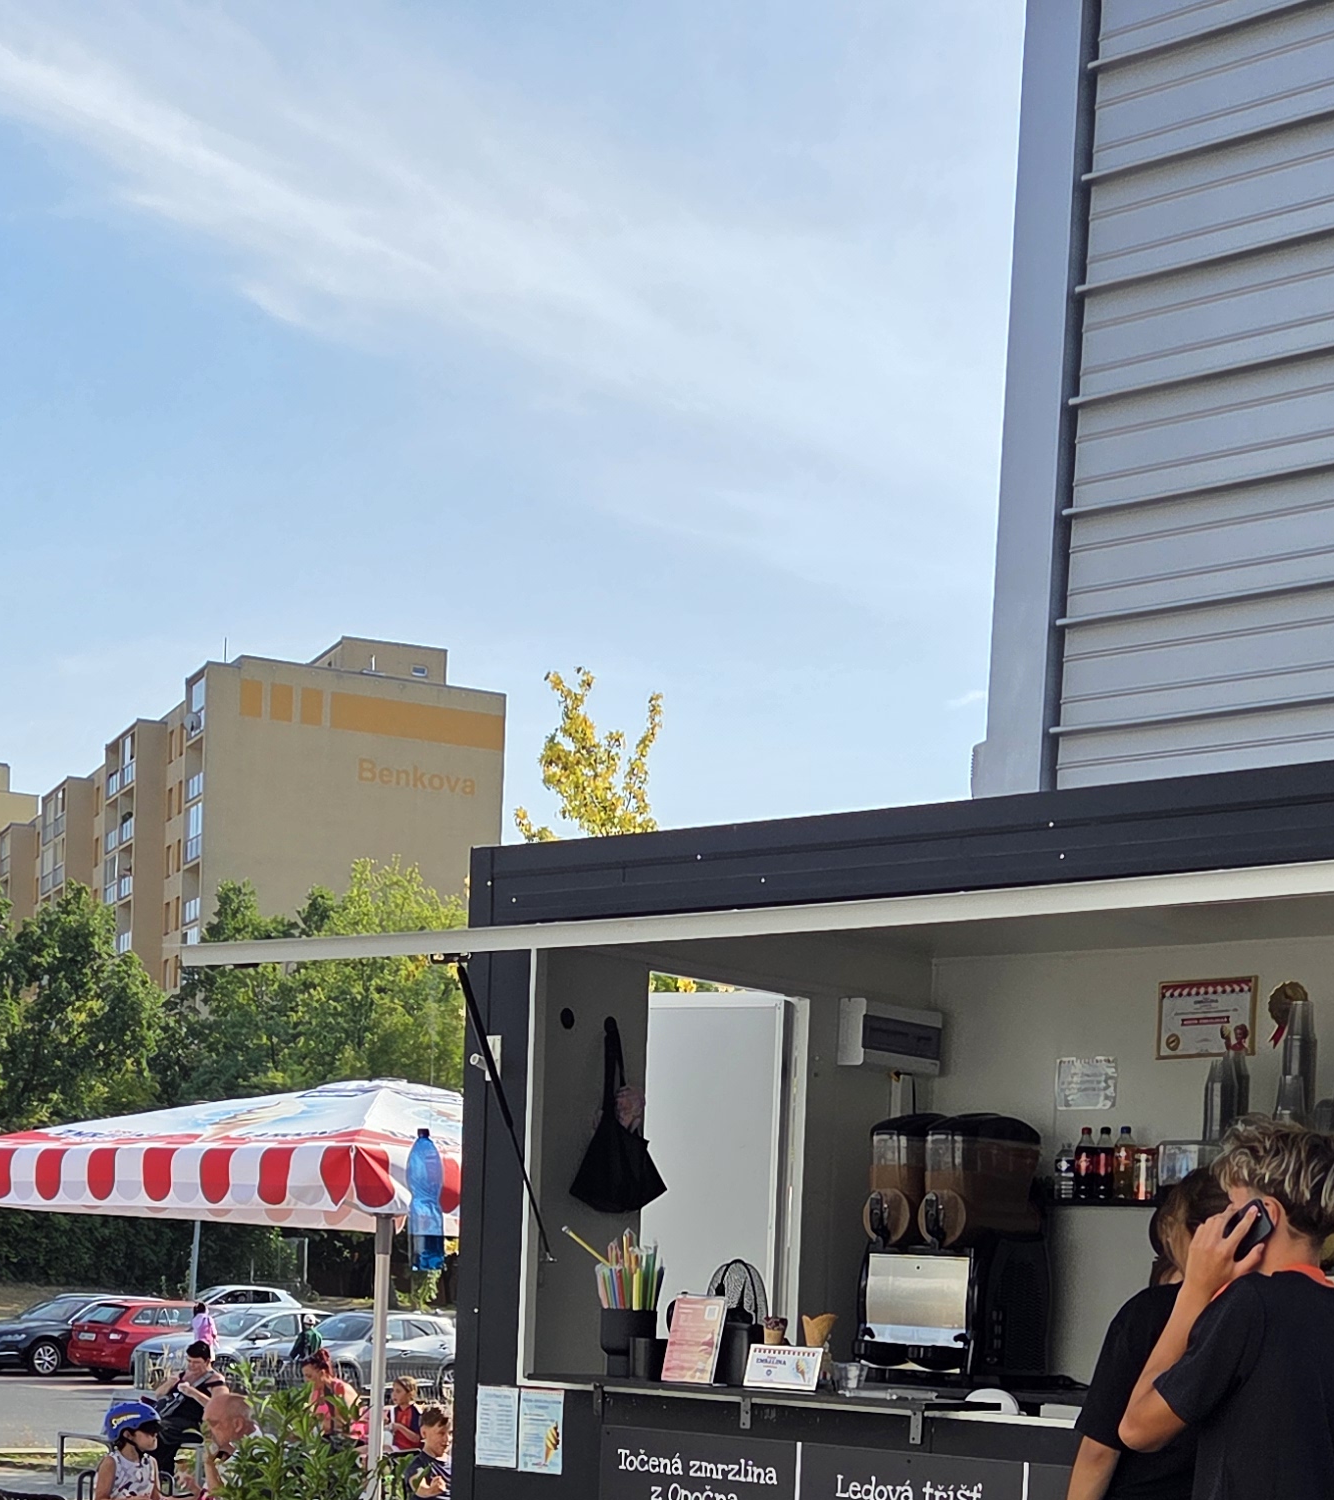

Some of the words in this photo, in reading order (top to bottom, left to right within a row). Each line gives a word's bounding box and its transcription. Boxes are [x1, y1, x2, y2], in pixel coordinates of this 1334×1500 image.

[358, 759, 475, 795] Benkova
[618, 1448, 683, 1475] Točená
[689, 1458, 778, 1485] zmrzlina
